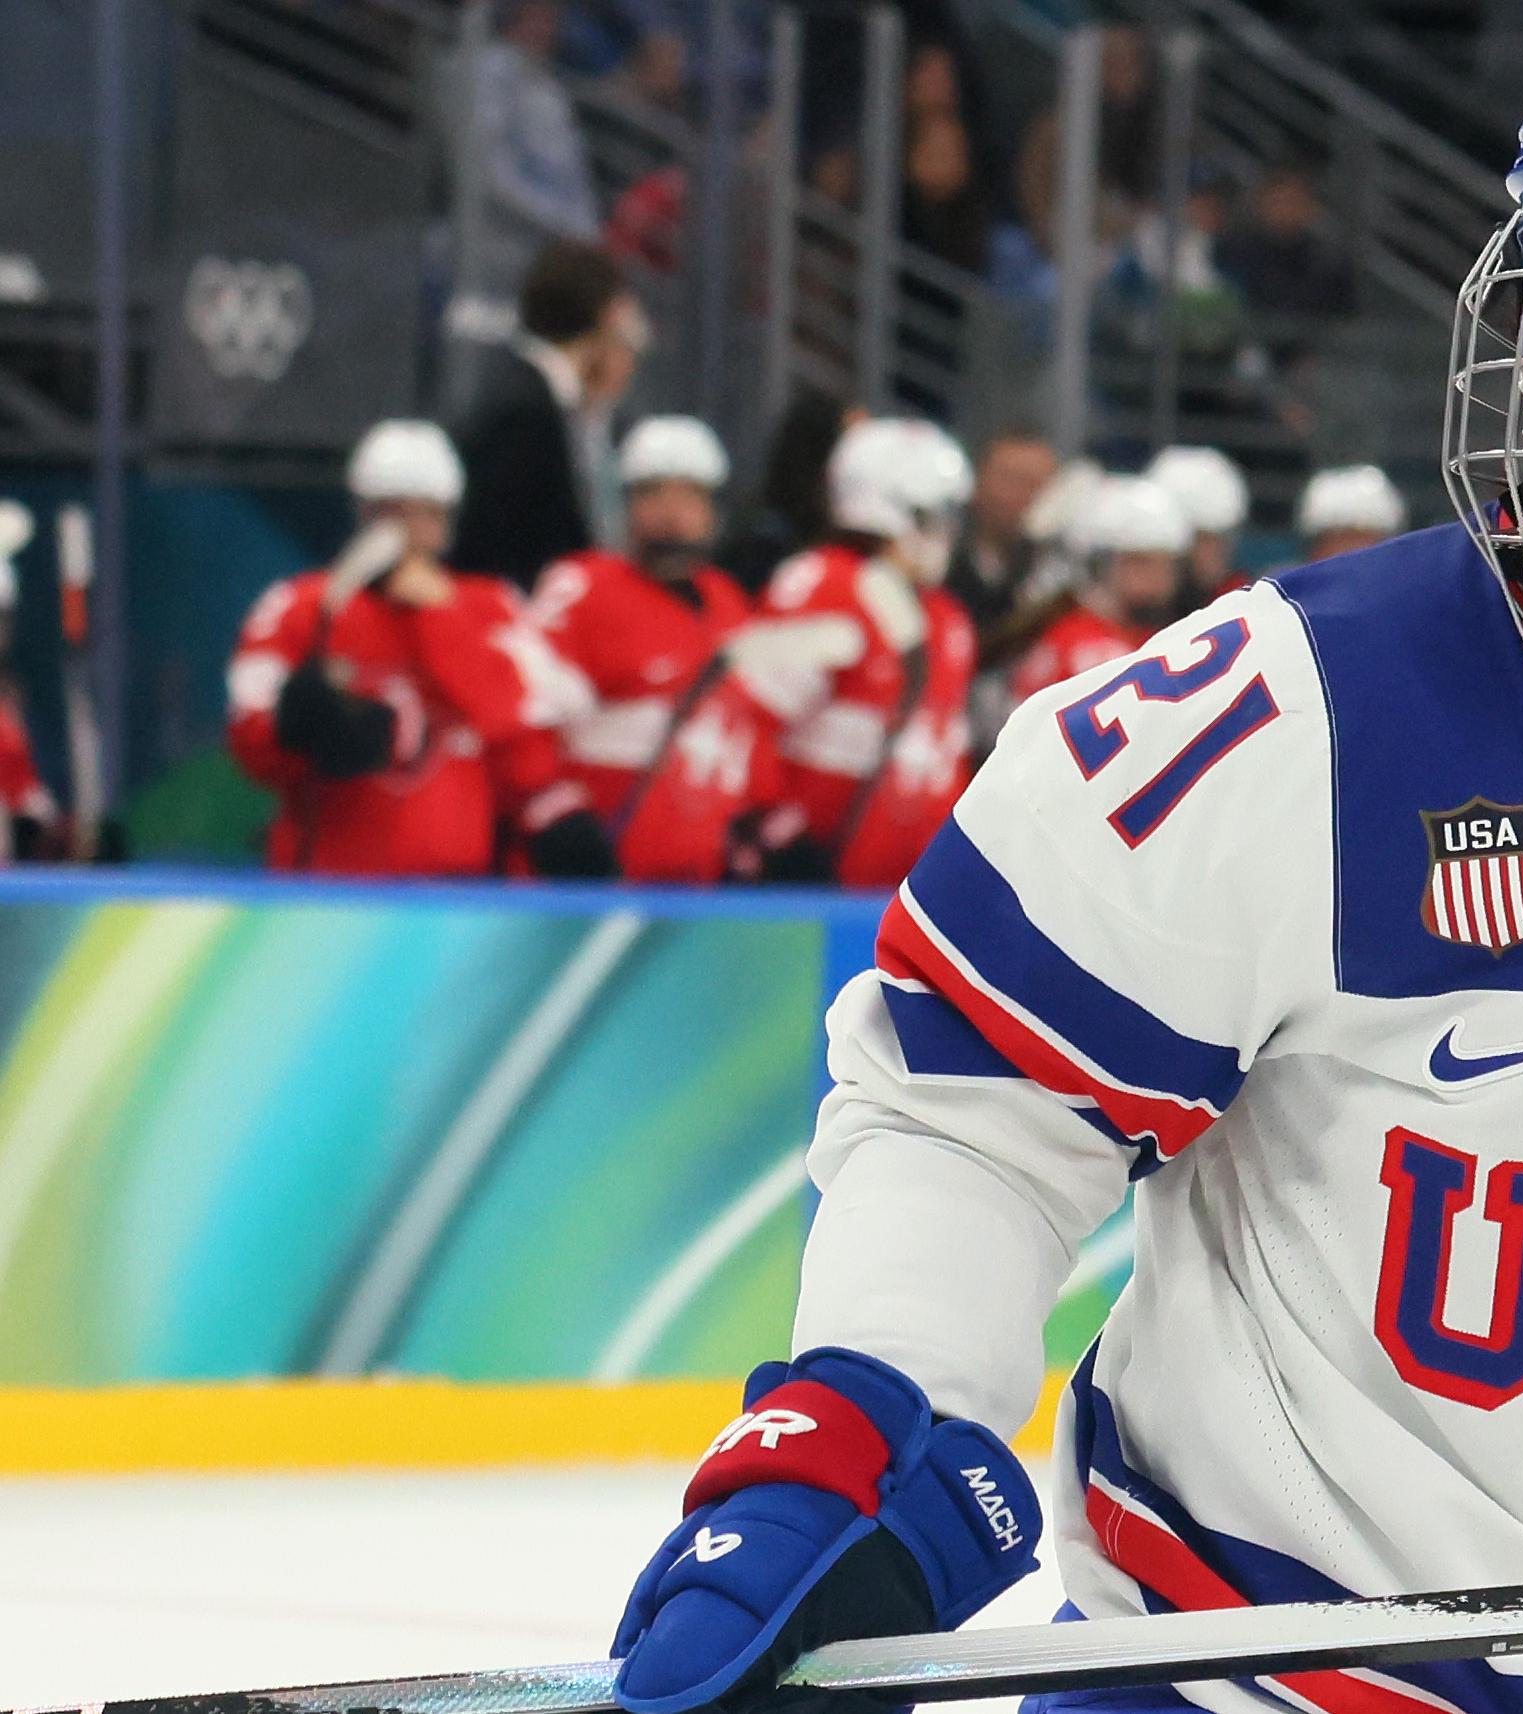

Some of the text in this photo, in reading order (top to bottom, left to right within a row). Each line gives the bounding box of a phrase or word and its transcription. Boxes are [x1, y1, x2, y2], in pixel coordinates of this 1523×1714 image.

[1055, 616, 1282, 851] 21
[1443, 817, 1519, 852] USA
[959, 1465, 1024, 1553] MACH
